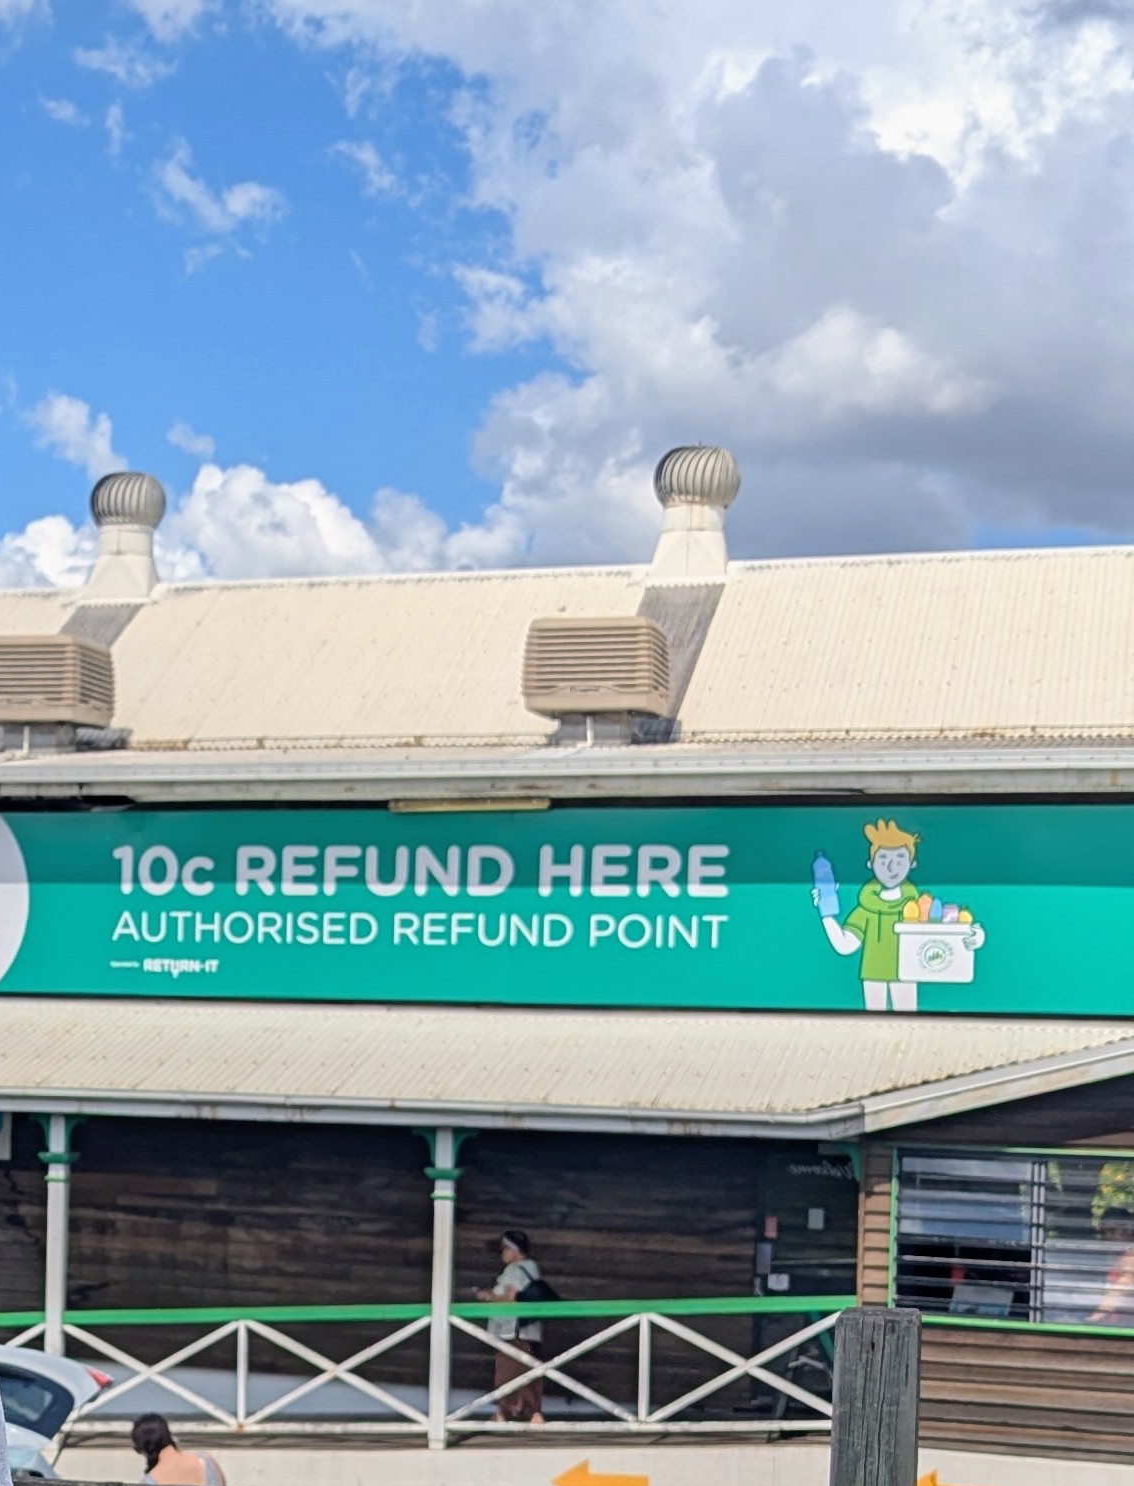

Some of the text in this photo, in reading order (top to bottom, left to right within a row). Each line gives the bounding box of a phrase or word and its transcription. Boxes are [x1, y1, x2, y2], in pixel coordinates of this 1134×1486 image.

[112, 844, 730, 898] 10c REFUND HERE
[111, 911, 730, 949] AUTHORISED REFUND POINT
